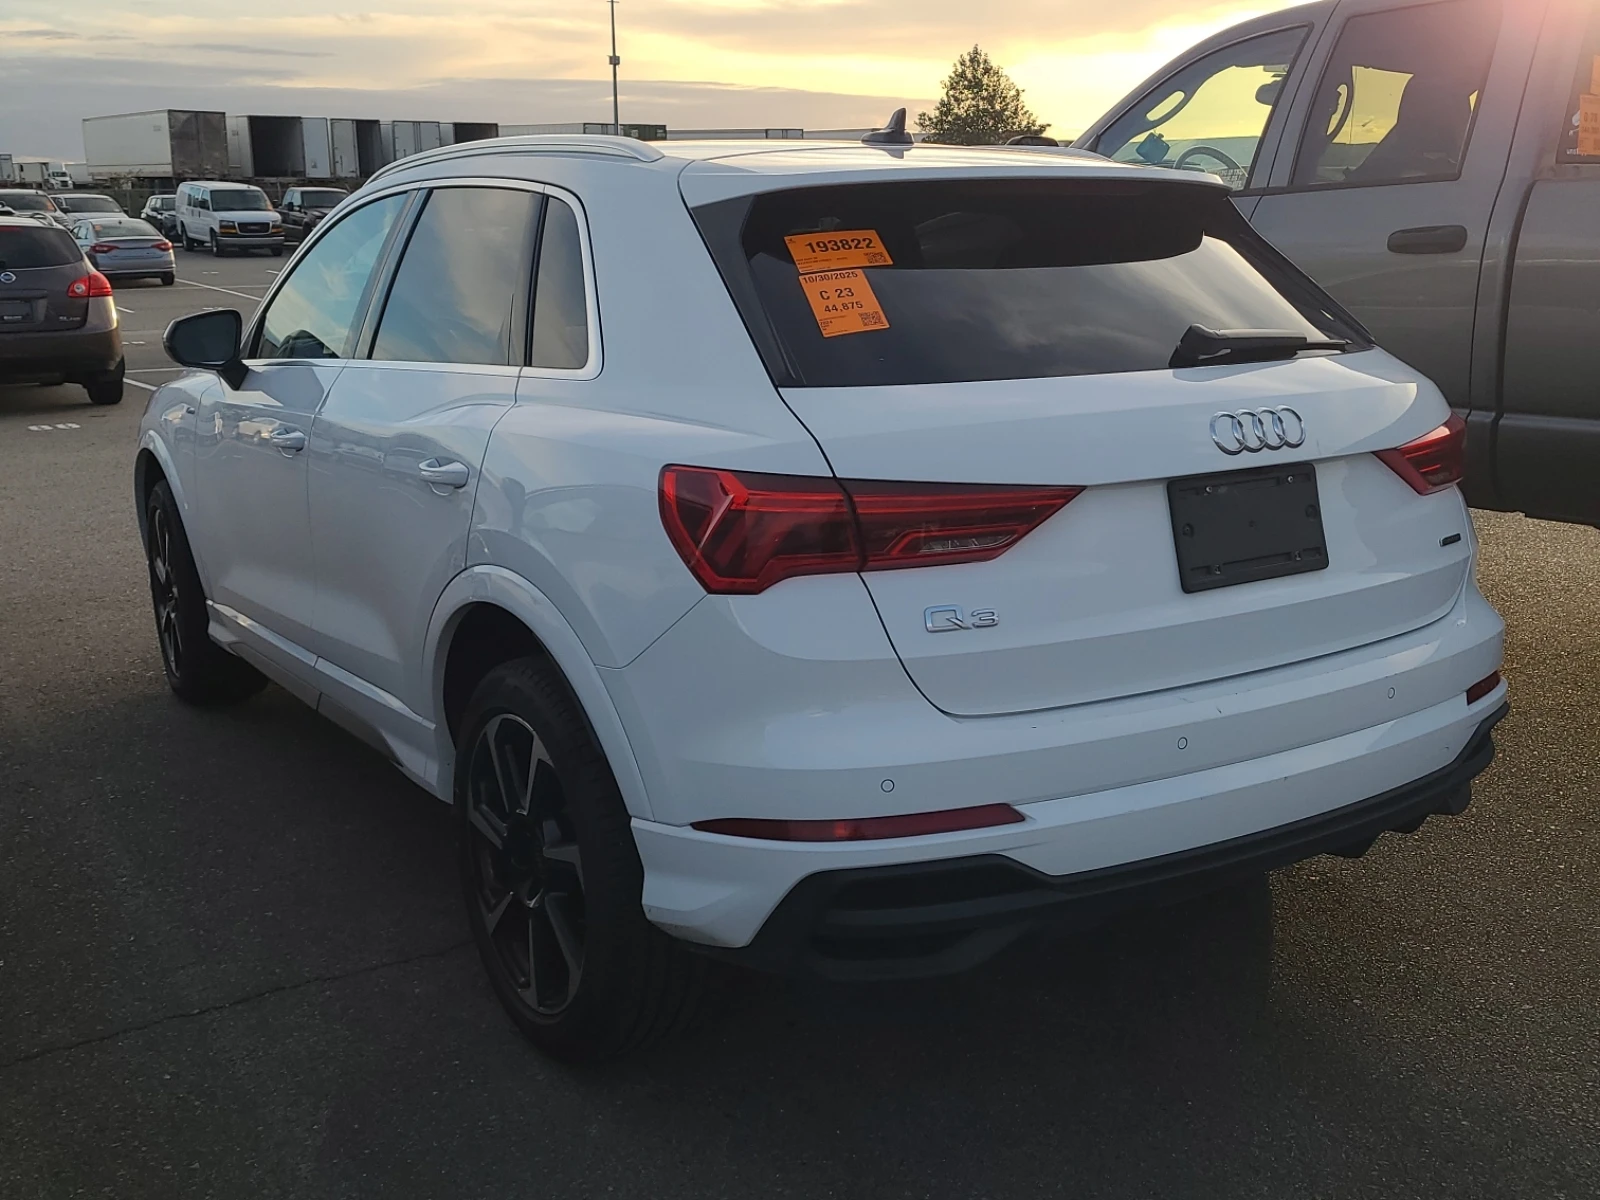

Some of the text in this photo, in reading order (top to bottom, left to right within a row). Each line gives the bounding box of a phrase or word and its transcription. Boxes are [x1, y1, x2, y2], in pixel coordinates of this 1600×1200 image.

[805, 237, 876, 253] 193822
[803, 271, 858, 284] 10/30/2025
[819, 287, 855, 300] C 23
[824, 300, 864, 313] 44,875
[924, 604, 999, 633] Q3
